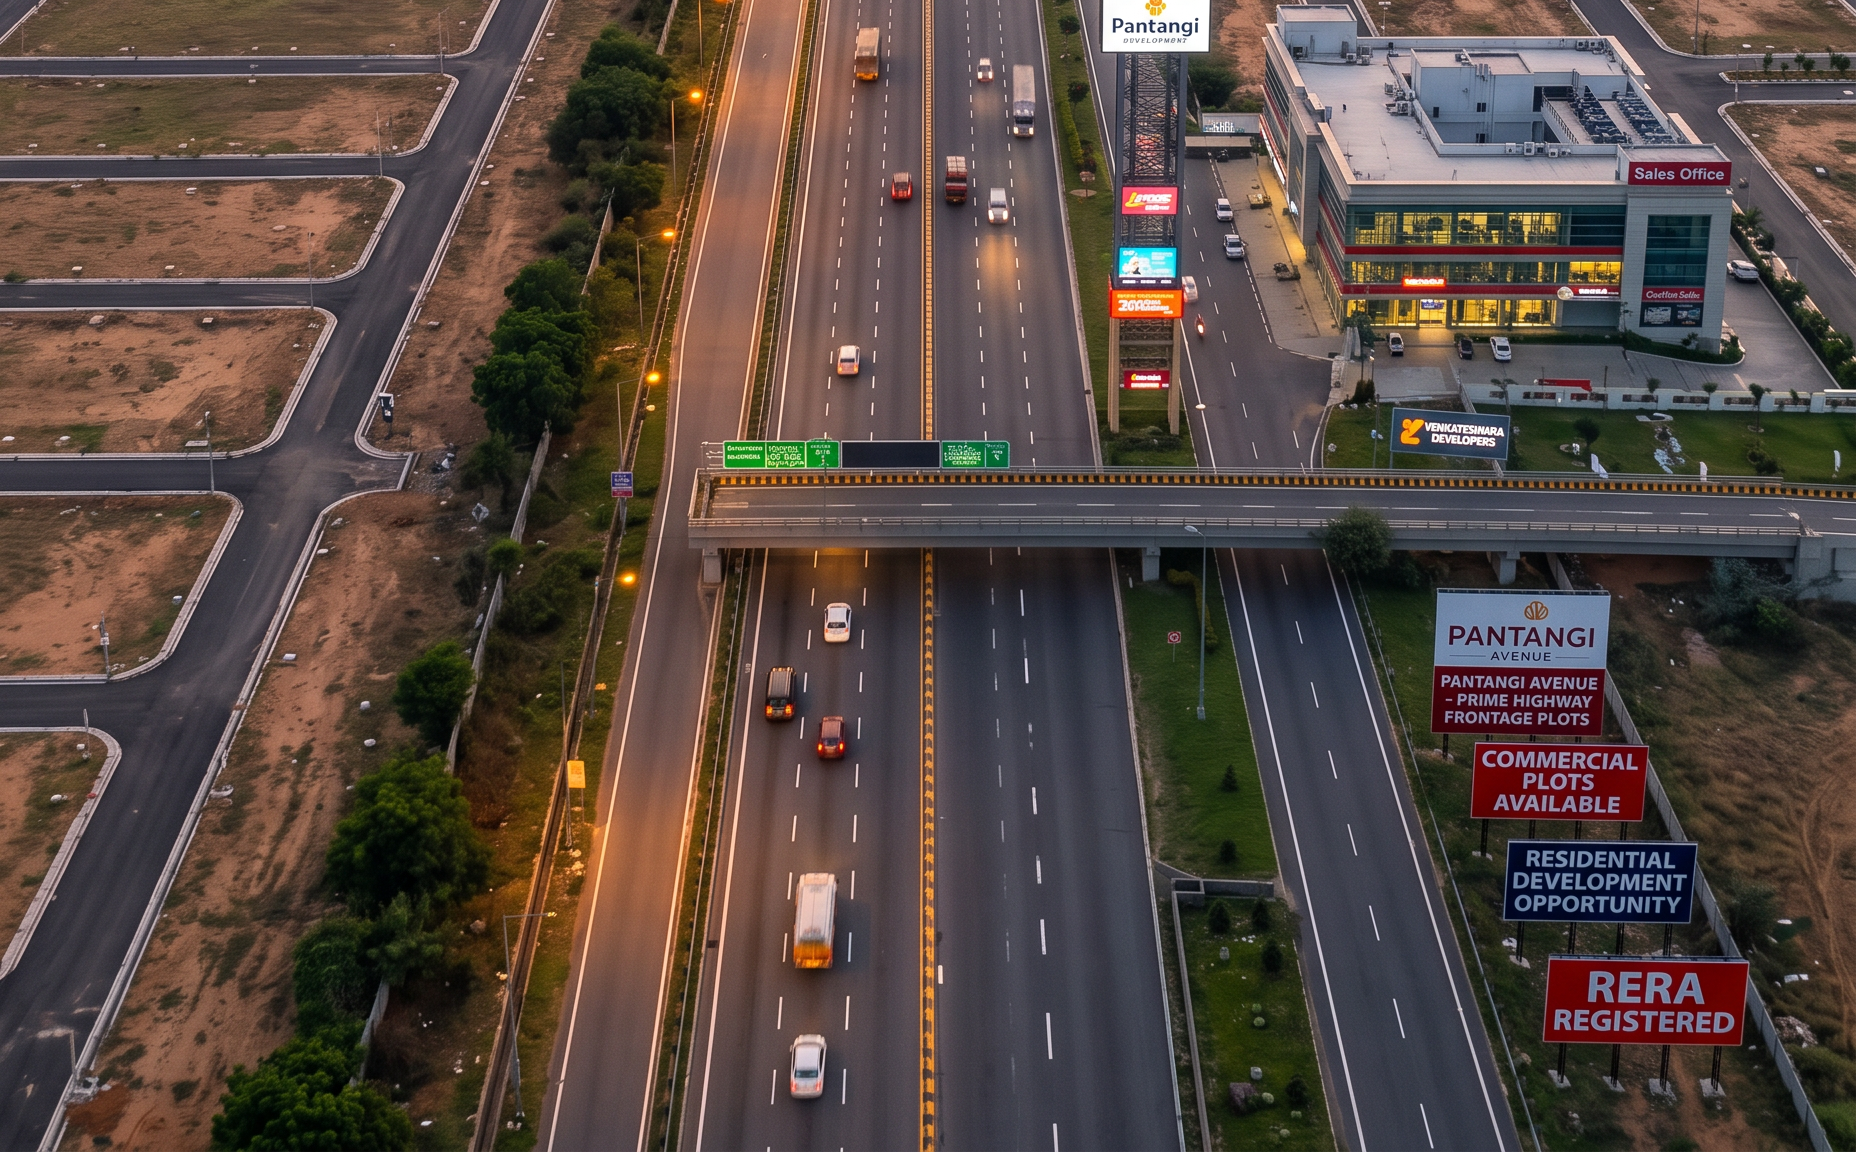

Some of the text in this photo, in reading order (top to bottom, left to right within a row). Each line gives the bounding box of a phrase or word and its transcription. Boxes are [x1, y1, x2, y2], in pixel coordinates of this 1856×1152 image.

[1112, 17, 1199, 37] Pantangi
[1634, 167, 1725, 180] Sales Office
[1431, 433, 1496, 447] DEVELOPERS
[1448, 625, 1595, 648] PANTANGI
[1490, 651, 1552, 662] AVENUE
[1441, 674, 1598, 691] PANTANGI AVENUE
[1457, 693, 1509, 707] PRIME
[1513, 695, 1593, 709] HIGHWAY
[1444, 710, 1590, 726] FRONTAGE PLOTS
[1481, 750, 1638, 771] COMMERCIAL
[1522, 773, 1595, 791] PLOTS
[1493, 794, 1621, 814] AVAILABLE
[1525, 849, 1676, 869] RESIDENTIAL
[1512, 871, 1688, 892] DEVELOPMENT
[1514, 893, 1682, 914] OPPORTUNITY
[1587, 970, 1706, 1005] RERA
[1553, 1009, 1735, 1034] REGISTERED
